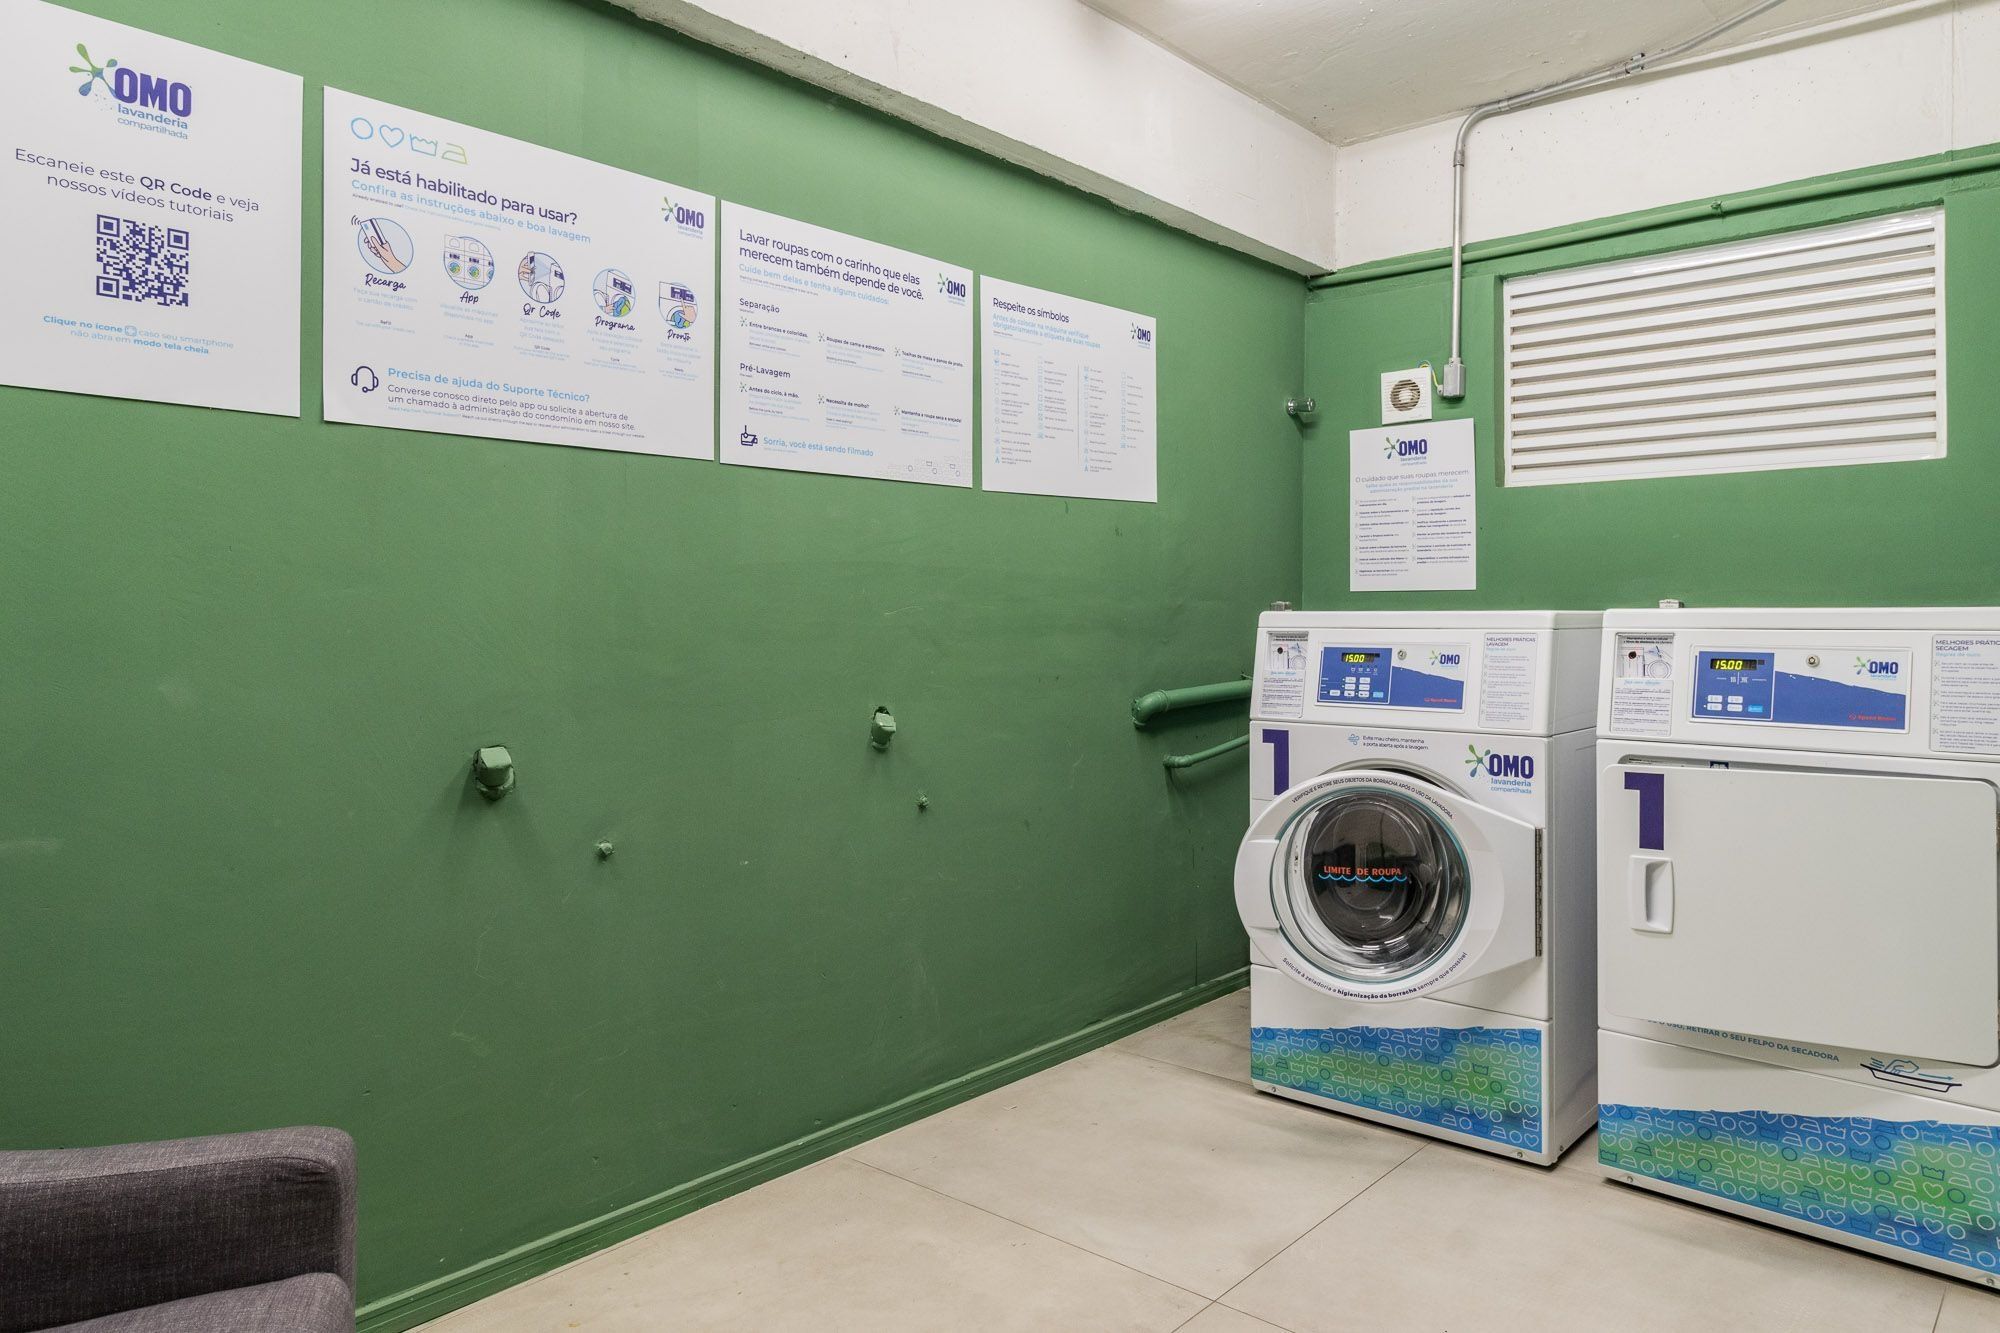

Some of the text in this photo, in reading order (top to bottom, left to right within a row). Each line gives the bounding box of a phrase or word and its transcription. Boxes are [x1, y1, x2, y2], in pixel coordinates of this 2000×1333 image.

[114, 67, 192, 117] OMO
[117, 103, 188, 129] lavanderia
[117, 117, 188, 140] compartilhada
[16, 148, 260, 211] Escaneie este QR Code e veja
[350, 157, 370, 176] Já
[375, 167, 412, 186] está
[416, 173, 498, 206] habilitado
[501, 198, 535, 217] para
[538, 206, 578, 226] usar?
[47, 176, 234, 223] nossos vídeos tutoriais
[351, 179, 397, 199] Confira
[400, 192, 413, 202] as
[416, 192, 476, 218] instruções
[479, 209, 515, 227] abaixo
[517, 219, 525, 228] e
[526, 221, 547, 234] boa
[548, 225, 591, 245] lavagem
[676, 206, 705, 229] OMO
[739, 228, 920, 286] Lavar roupas com o carinho que elas
[364, 273, 406, 292] Recarga
[739, 245, 793, 267] merecem
[795, 256, 840, 280] também
[842, 270, 886, 292] depende
[887, 280, 900, 294] de
[900, 284, 925, 301] você.
[739, 263, 762, 275] Cuide
[763, 267, 782, 280] bem
[782, 271, 803, 286] delas
[810, 277, 832, 292] tenha
[832, 283, 857, 299] alguns
[459, 291, 479, 304] App
[946, 279, 966, 298] OMO
[538, 304, 561, 318] Code
[738, 298, 780, 314] Separação
[993, 297, 1070, 323] Respeite os símbolos
[43, 315, 234, 350] Clique no ícone caso seu smartphone
[595, 315, 636, 331] Programa
[666, 329, 691, 342] Pronto
[1136, 328, 1151, 343] OMO
[70, 329, 209, 355] não abra em modo tela cheia
[739, 362, 791, 379] Pré-Lavagem
[388, 367, 590, 402] Precisa de ajuda do Suporte Técnico?
[387, 384, 431, 397] Converse
[432, 390, 470, 402] conosco
[471, 393, 498, 405] direto
[499, 396, 518, 408] pelo
[519, 400, 536, 411] app
[537, 402, 548, 410] ou
[549, 402, 577, 415] solicite
[584, 408, 616, 421] abertura
[617, 412, 628, 421] de
[387, 396, 405, 405] um
[406, 396, 450, 409] chamado
[451, 401, 458, 410] à
[459, 402, 521, 419] administração
[522, 409, 534, 419] do
[534, 411, 583, 426] condomínio
[583, 417, 597, 426] em
[598, 419, 620, 430] nosso
[763, 437, 874, 457] Sorria, você está sendo filmado
[1399, 438, 1428, 457] OMO
[1361, 474, 1386, 483] cuidado
[1415, 471, 1437, 480] roupas
[1438, 469, 1469, 477] merecem
[1439, 654, 1460, 665] OMO
[1869, 661, 1899, 675] OMO
[1489, 753, 1535, 780] OMO
[1292, 788, 1313, 803] VERIFIQUE
[1317, 780, 1332, 789] RETIRE
[1373, 777, 1398, 786] BORRACHA
[1490, 786, 1532, 795] compartilhada
[1491, 777, 1531, 787] lavanderia
[1624, 771, 1664, 851] 1
[1323, 865, 1402, 876] LIMITE DE ROUPA
[1282, 957, 1301, 974] Solicite
[1305, 975, 1332, 991] zeladoria
[1337, 988, 1378, 1000] higienização
[1388, 987, 1417, 998] borracha
[1417, 977, 1439, 991] sempre
[1438, 969, 1450, 979] que
[1449, 951, 1468, 972] possível
[1730, 1032, 1746, 1042] SEU
[1747, 1036, 1775, 1048] FELPO
[1776, 1042, 1789, 1051] DA
[1790, 1046, 1840, 1063] SECADORA
